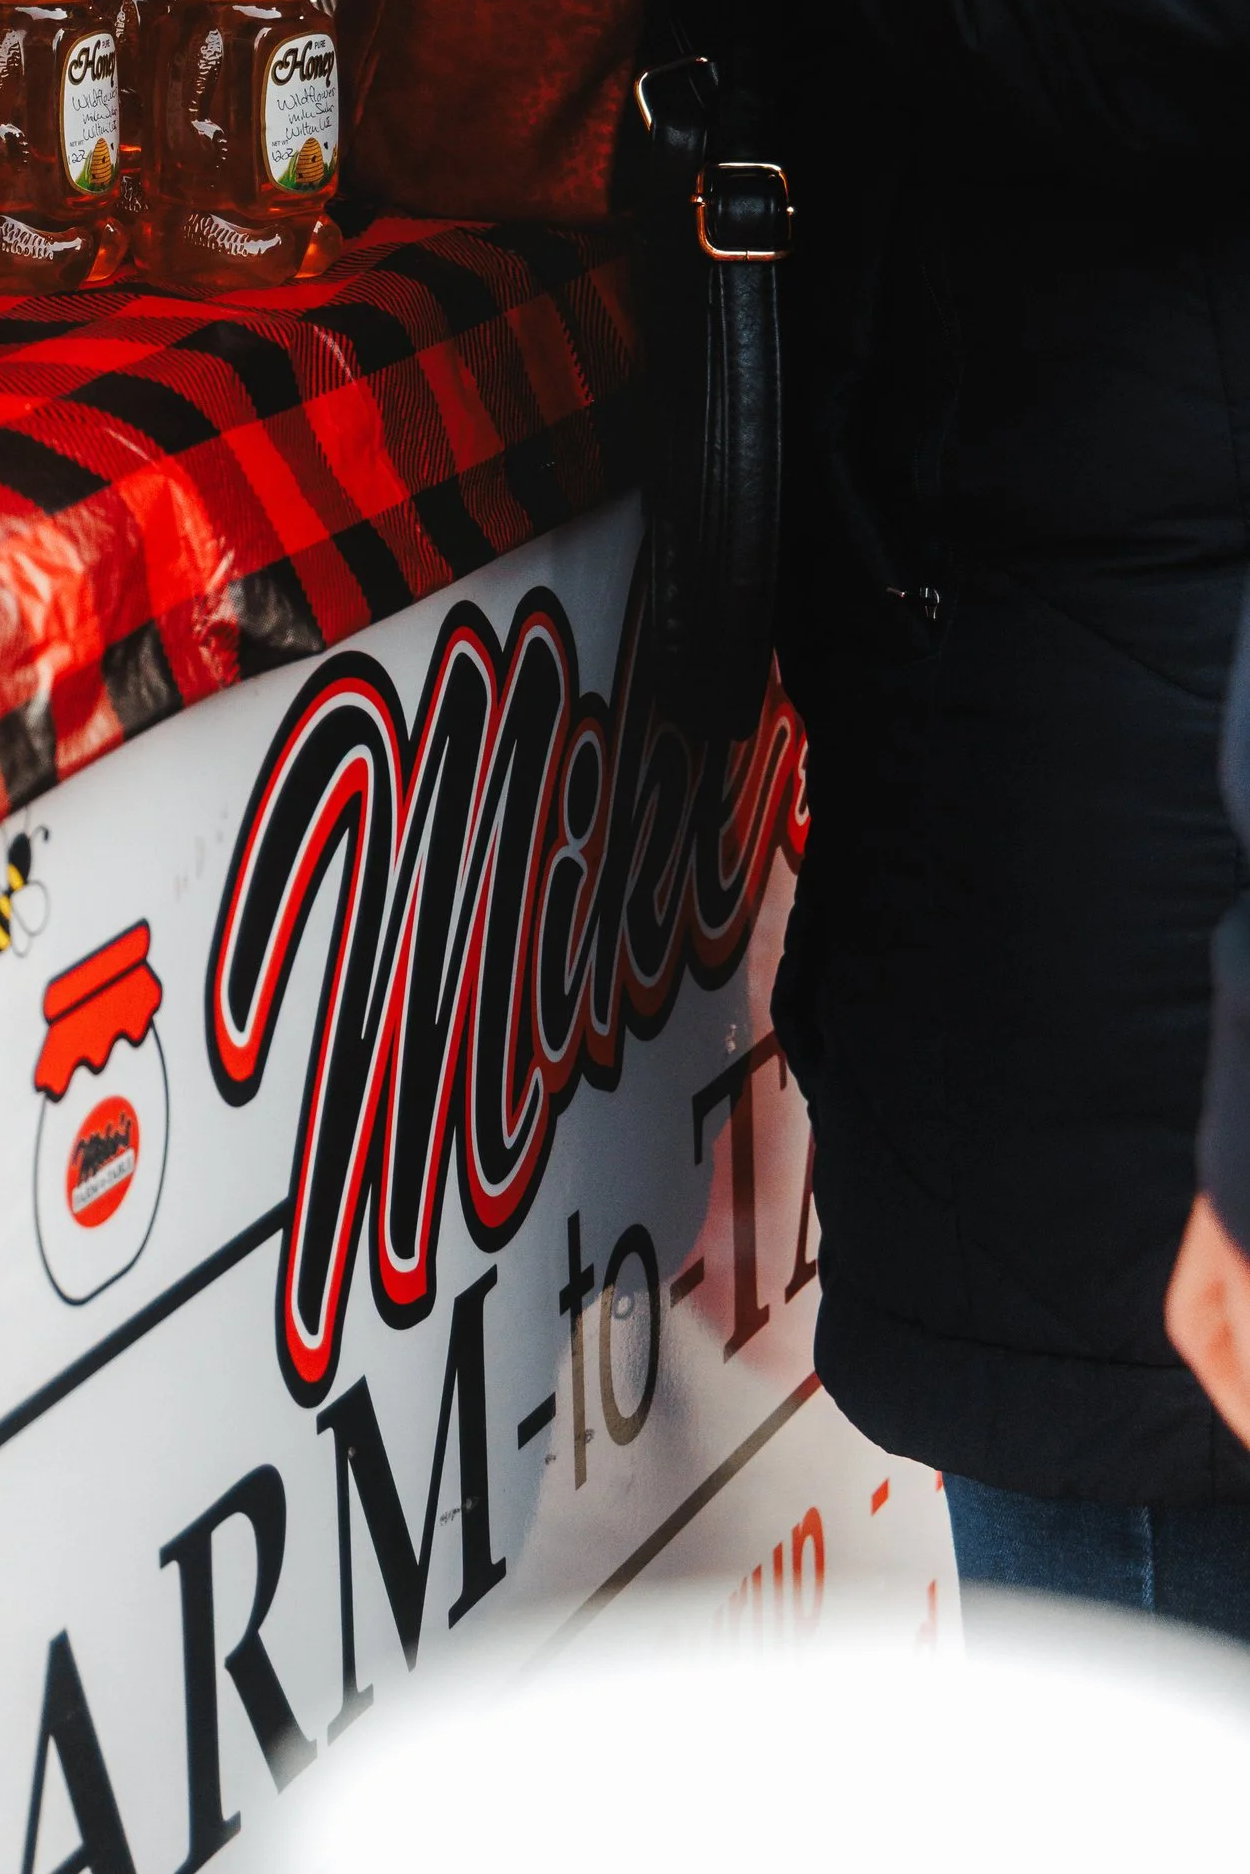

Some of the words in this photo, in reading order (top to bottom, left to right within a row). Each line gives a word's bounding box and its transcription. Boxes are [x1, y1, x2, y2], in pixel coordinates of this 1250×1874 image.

[68, 39, 116, 88] Honey
[271, 40, 335, 88] Honey
[314, 40, 326, 50] PURE
